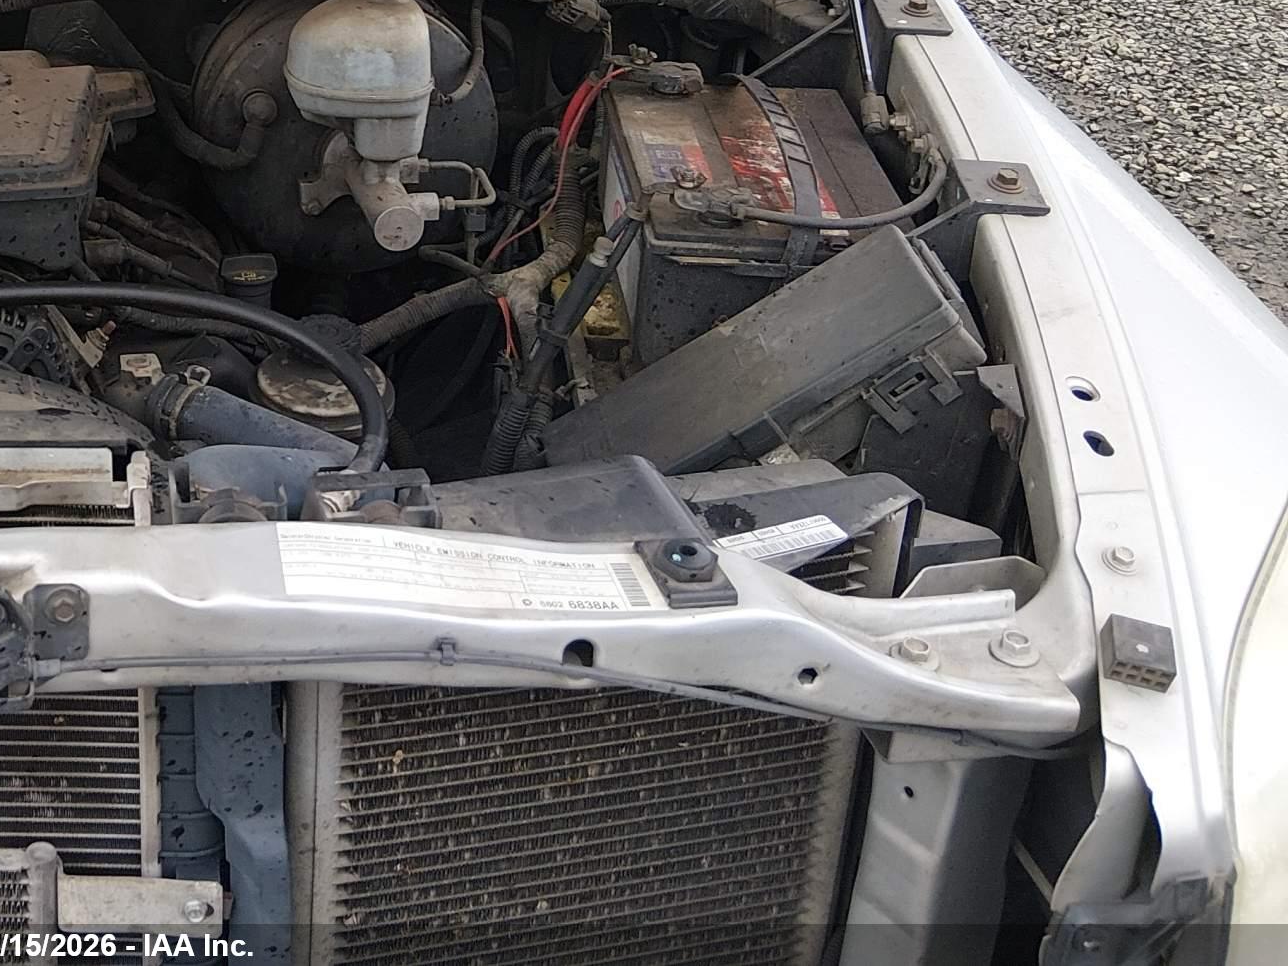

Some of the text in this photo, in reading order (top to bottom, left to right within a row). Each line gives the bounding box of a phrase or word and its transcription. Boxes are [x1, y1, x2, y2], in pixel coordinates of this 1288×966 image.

[394, 541, 596, 570] VEHICLE EMISSION CONTROL INFORMATION
